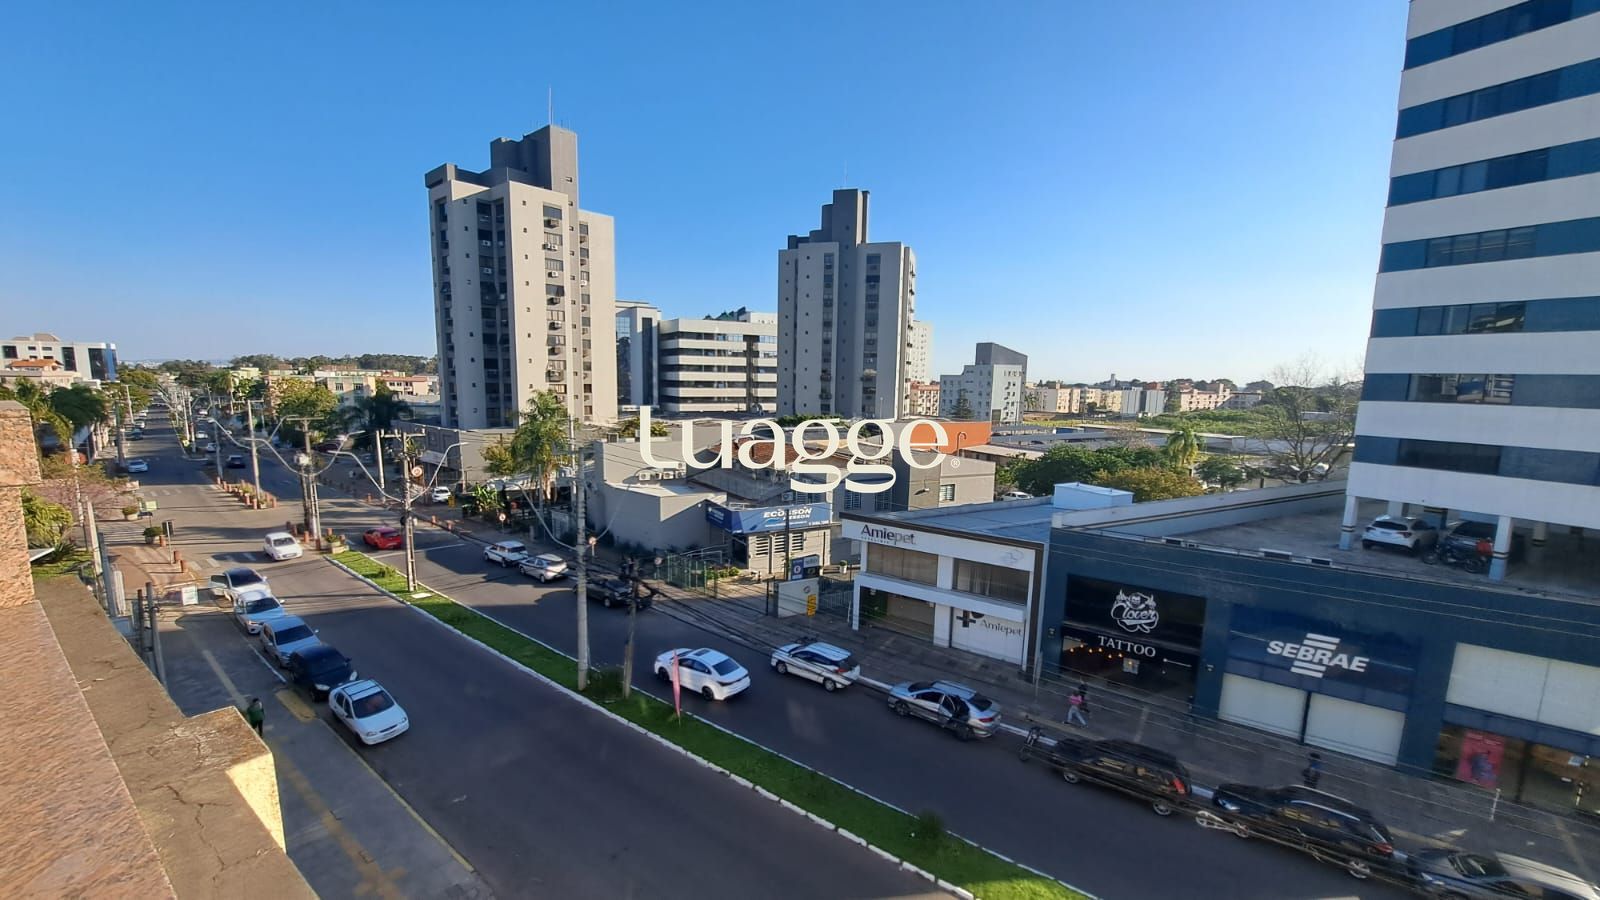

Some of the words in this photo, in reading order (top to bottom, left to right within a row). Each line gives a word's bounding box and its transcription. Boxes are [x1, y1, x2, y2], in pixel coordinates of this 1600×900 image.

[860, 524, 917, 546] Amiepet
[980, 619, 1023, 637] Amiepet
[1097, 635, 1157, 658] TATTOO
[1266, 640, 1370, 673] SEBRAE
